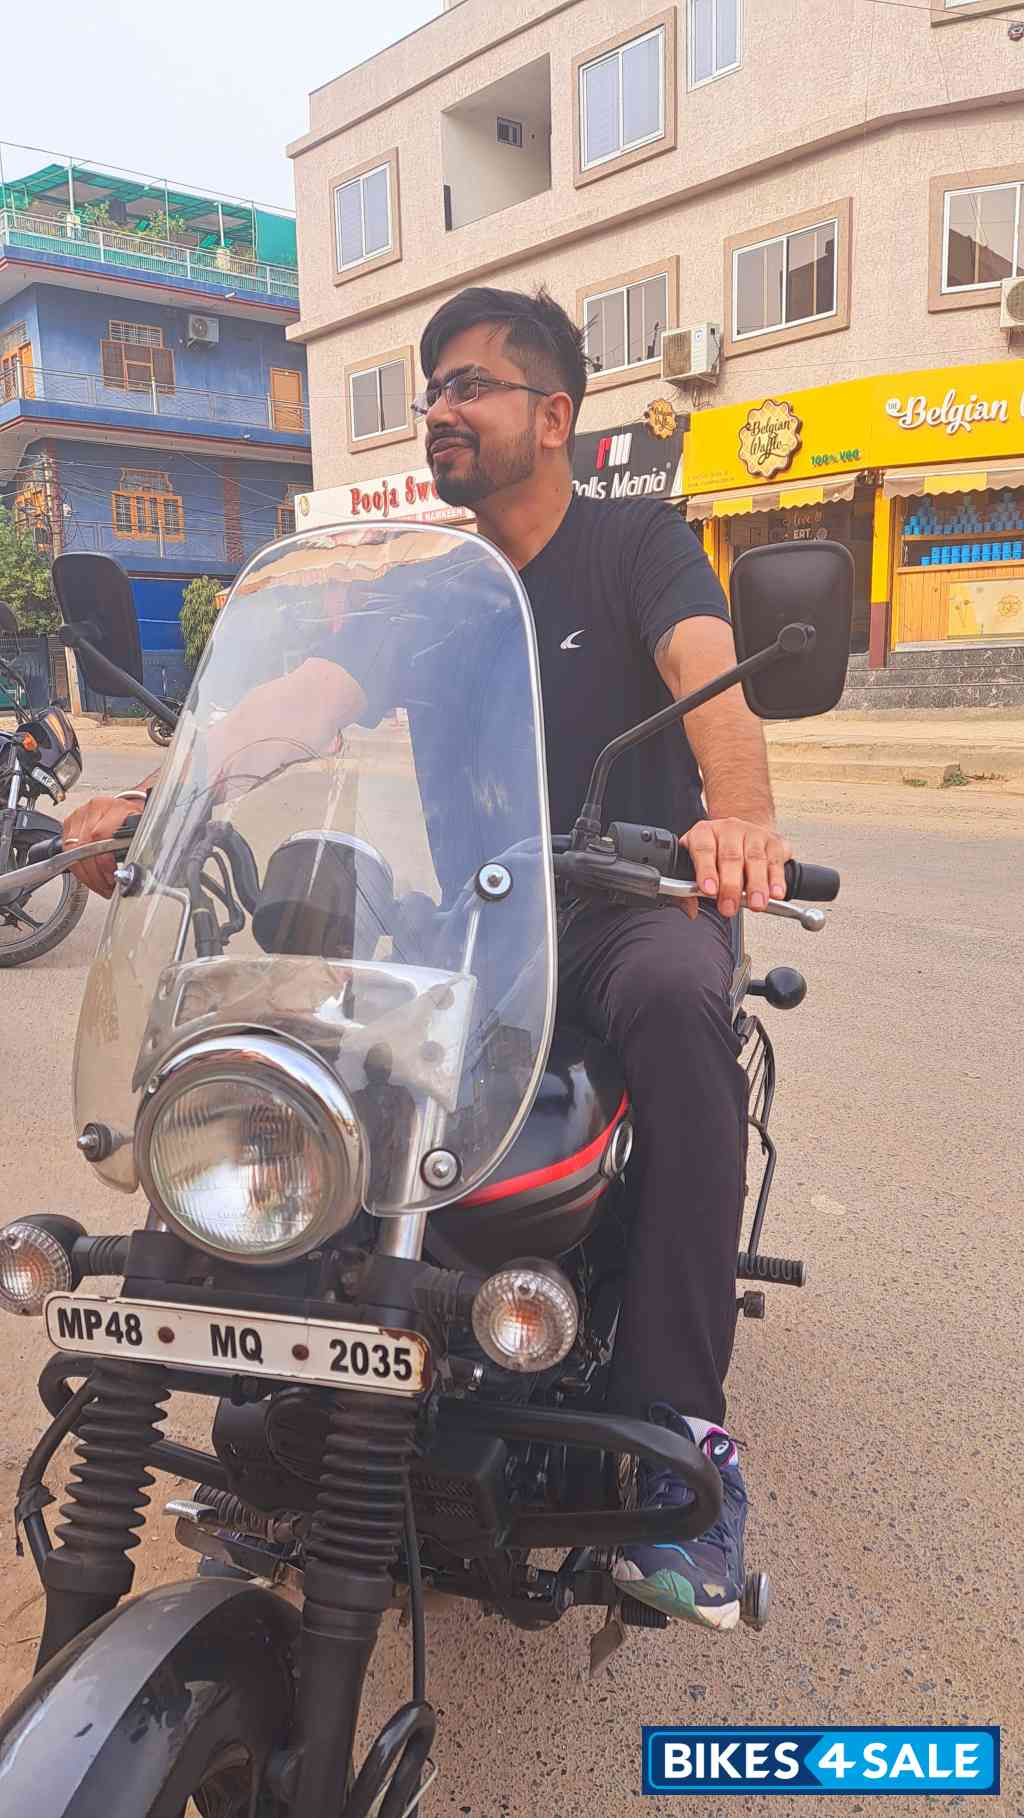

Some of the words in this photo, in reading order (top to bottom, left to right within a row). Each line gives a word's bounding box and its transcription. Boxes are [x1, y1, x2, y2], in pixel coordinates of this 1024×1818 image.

[750, 416, 791, 436] Belgian
[897, 389, 1009, 435] Belgian
[750, 432, 790, 465] Waffle
[350, 480, 400, 517] Pooja
[610, 467, 667, 499] Mania
[57, 1306, 144, 1347] MP48
[210, 1323, 264, 1365] MQ
[328, 1338, 413, 1382] 2035
